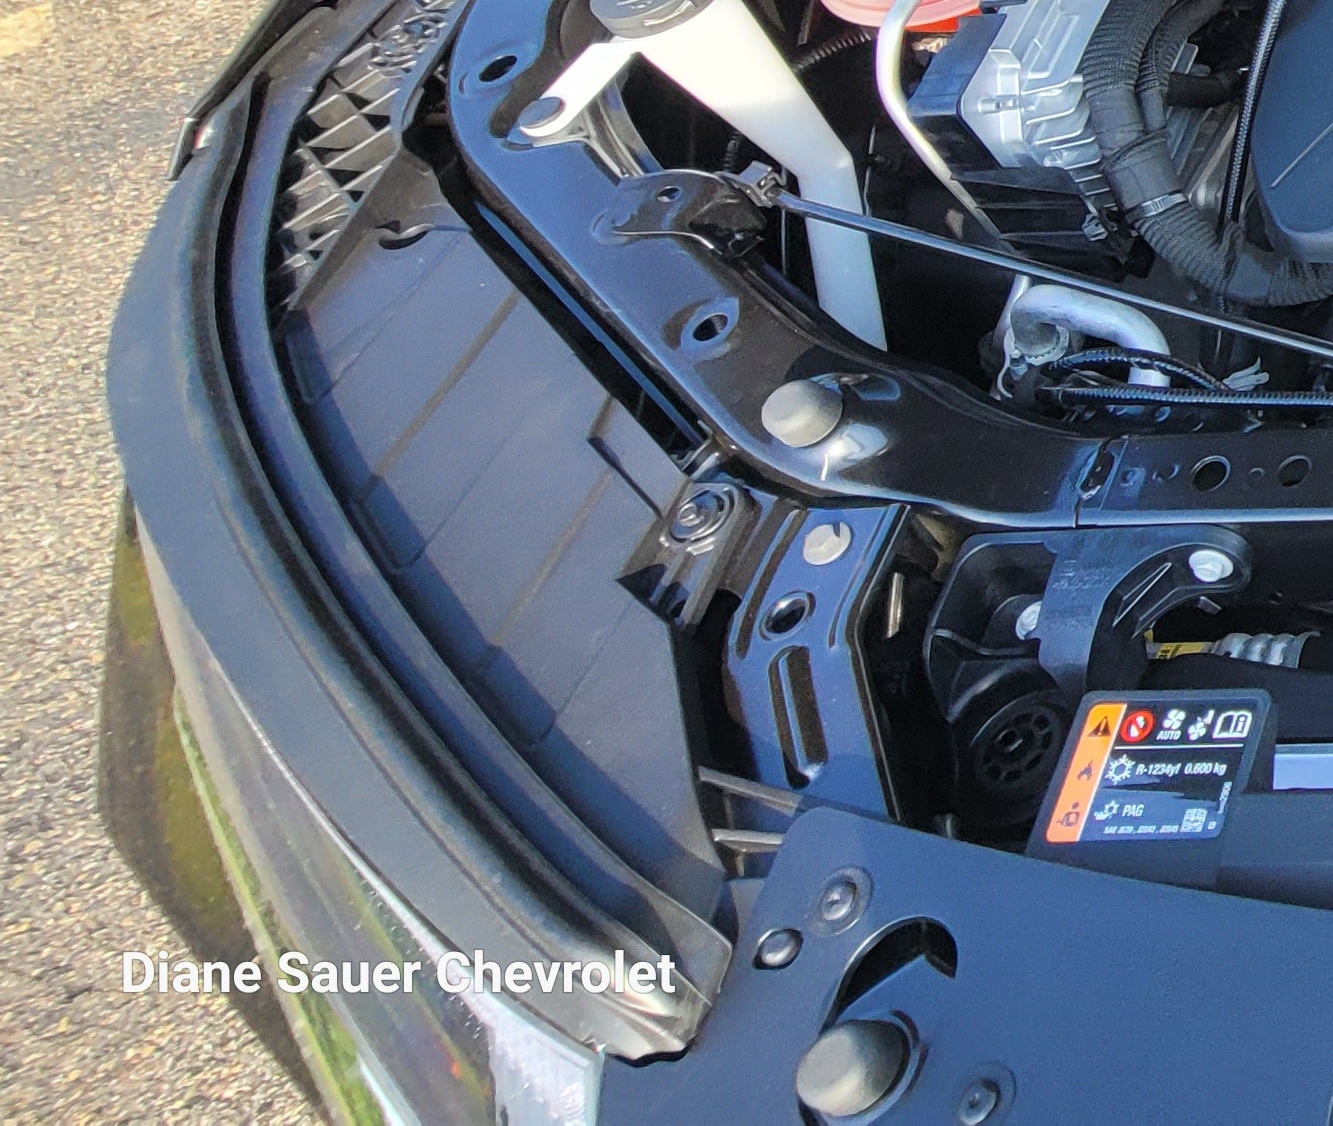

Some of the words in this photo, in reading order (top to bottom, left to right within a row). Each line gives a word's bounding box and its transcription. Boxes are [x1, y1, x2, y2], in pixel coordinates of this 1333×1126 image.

[1156, 730, 1182, 741] AUTO
[1135, 762, 1182, 778] R-1234yf
[1184, 762, 1213, 775] 0.600
[1212, 762, 1228, 777] kg
[1121, 804, 1145, 817] PAG
